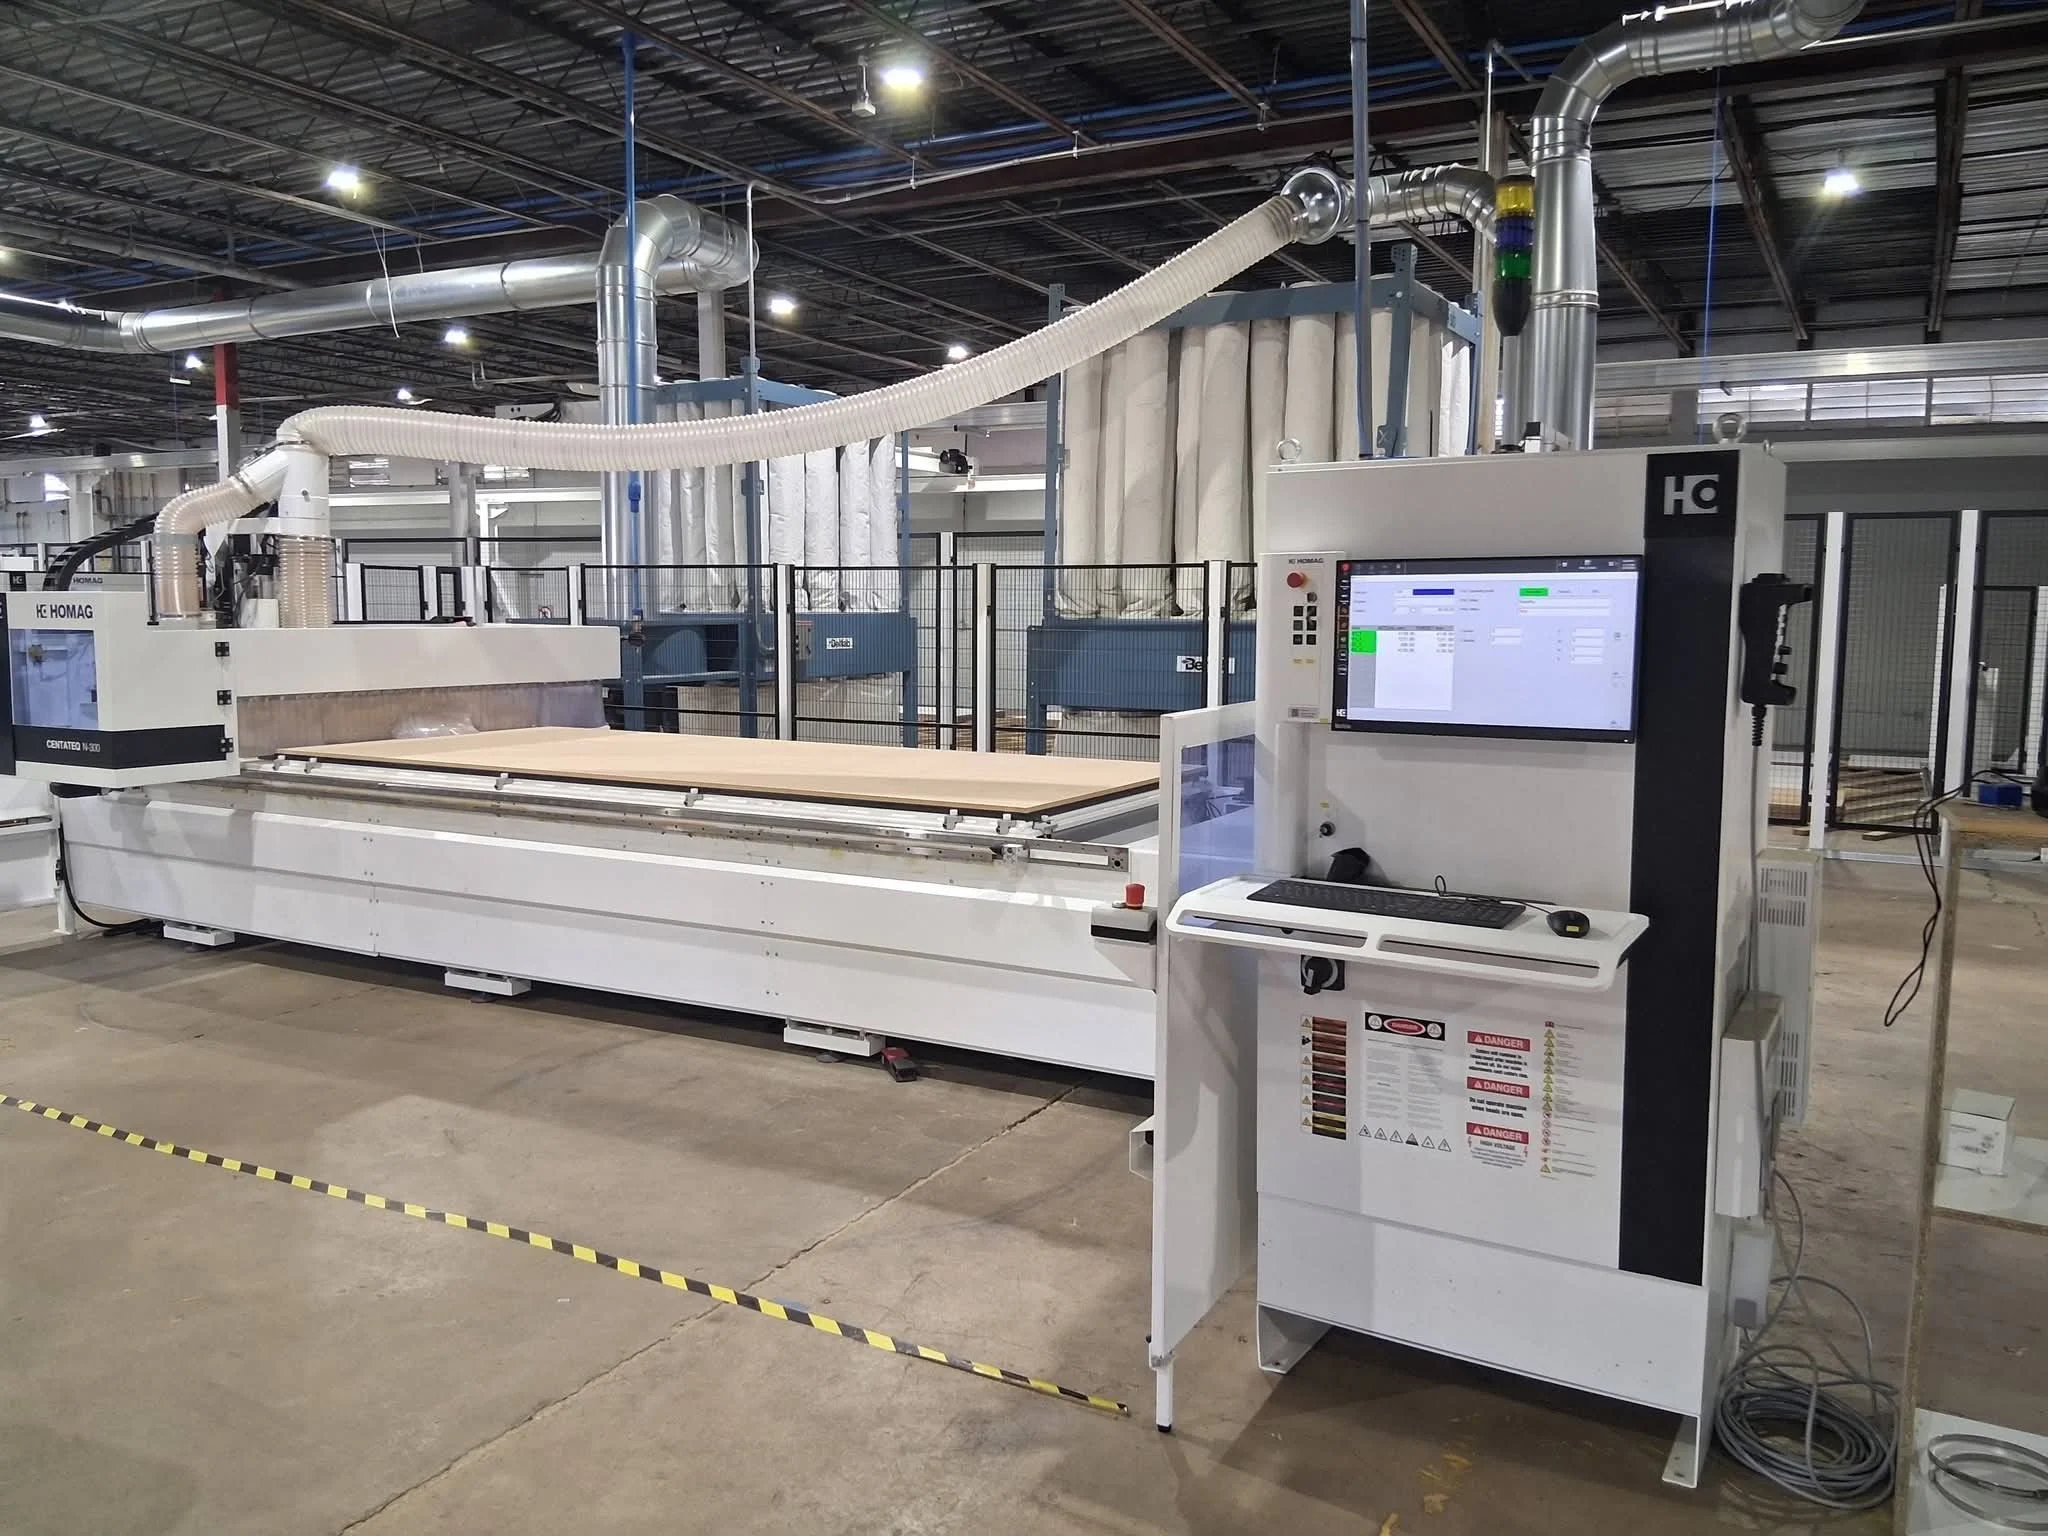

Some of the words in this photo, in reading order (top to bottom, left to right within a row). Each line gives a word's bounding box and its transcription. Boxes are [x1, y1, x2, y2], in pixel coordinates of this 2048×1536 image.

[50, 604, 94, 619] HOMAG
[1483, 1035, 1524, 1049] DANGER
[1483, 1081, 1523, 1095] DANGER
[1482, 1127, 1522, 1141] DANGER
